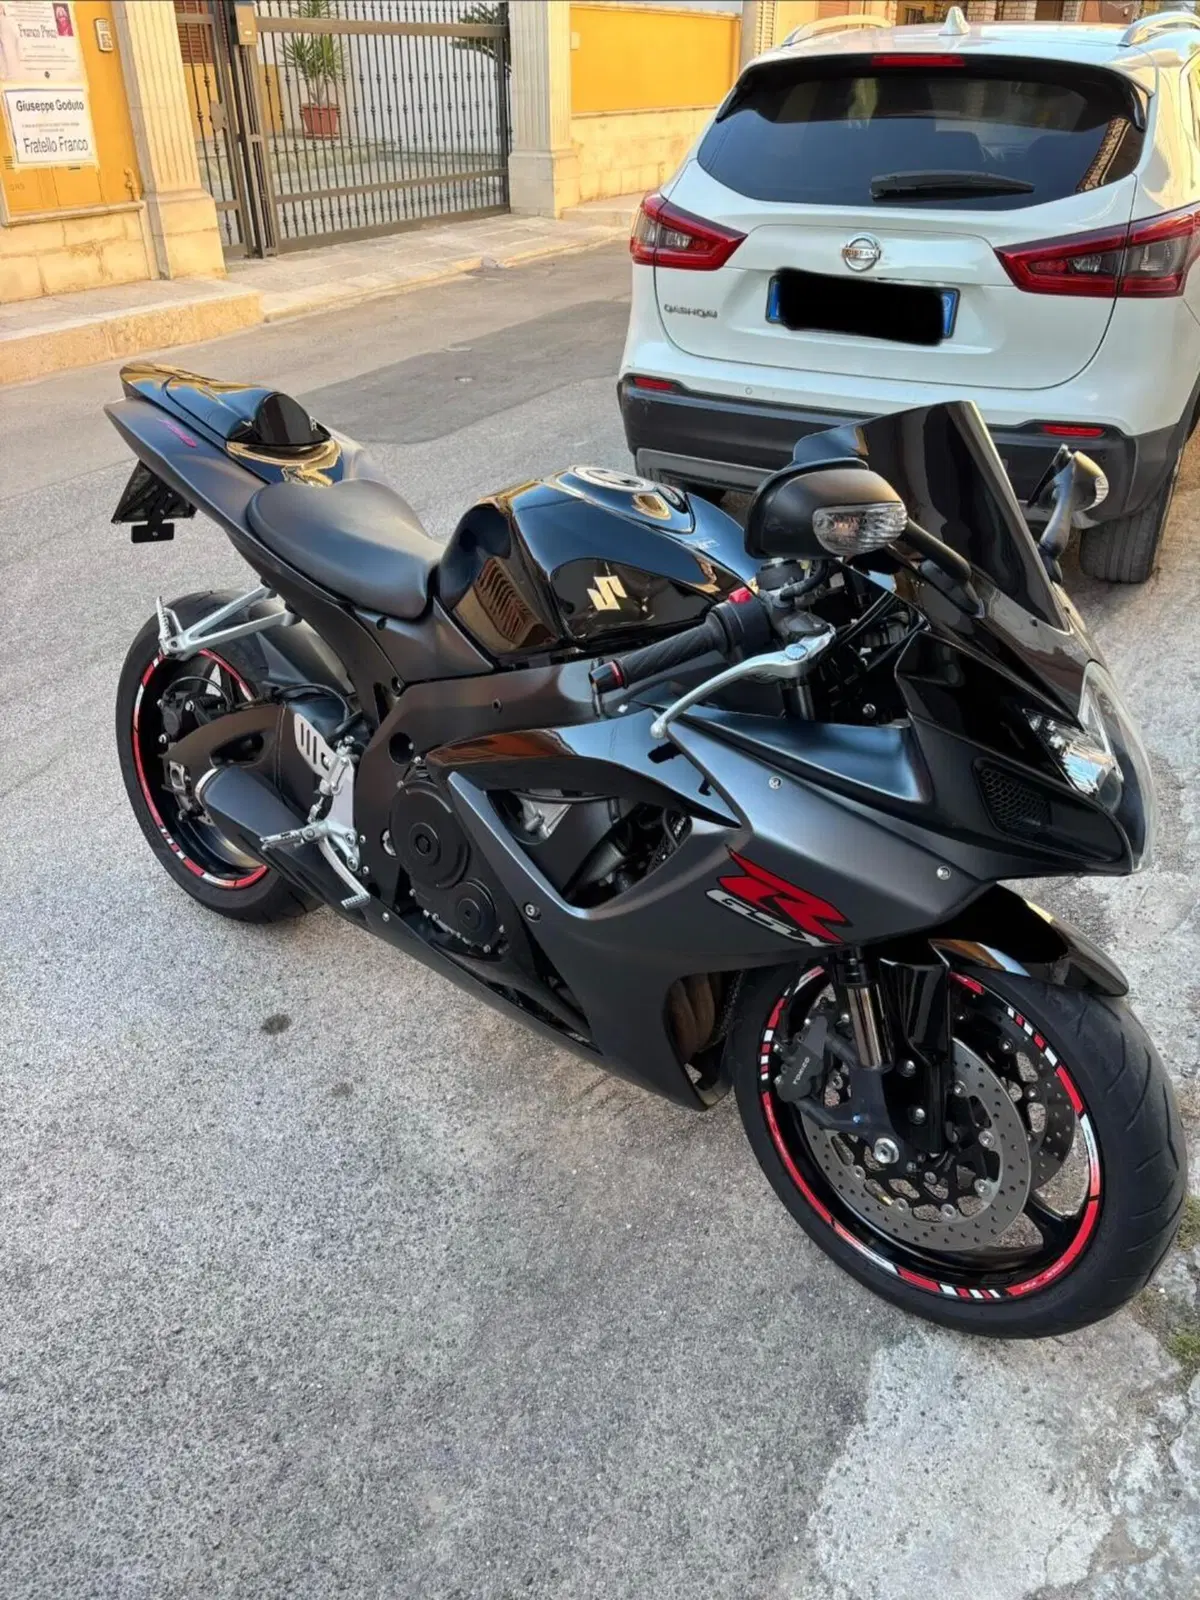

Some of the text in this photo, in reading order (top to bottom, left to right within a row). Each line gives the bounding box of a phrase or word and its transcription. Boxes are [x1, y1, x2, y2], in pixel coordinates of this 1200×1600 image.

[16, 98, 84, 113] Giuseppe Goduto
[23, 135, 88, 153] Fratello Franco
[664, 304, 717, 319] QASHQAI
